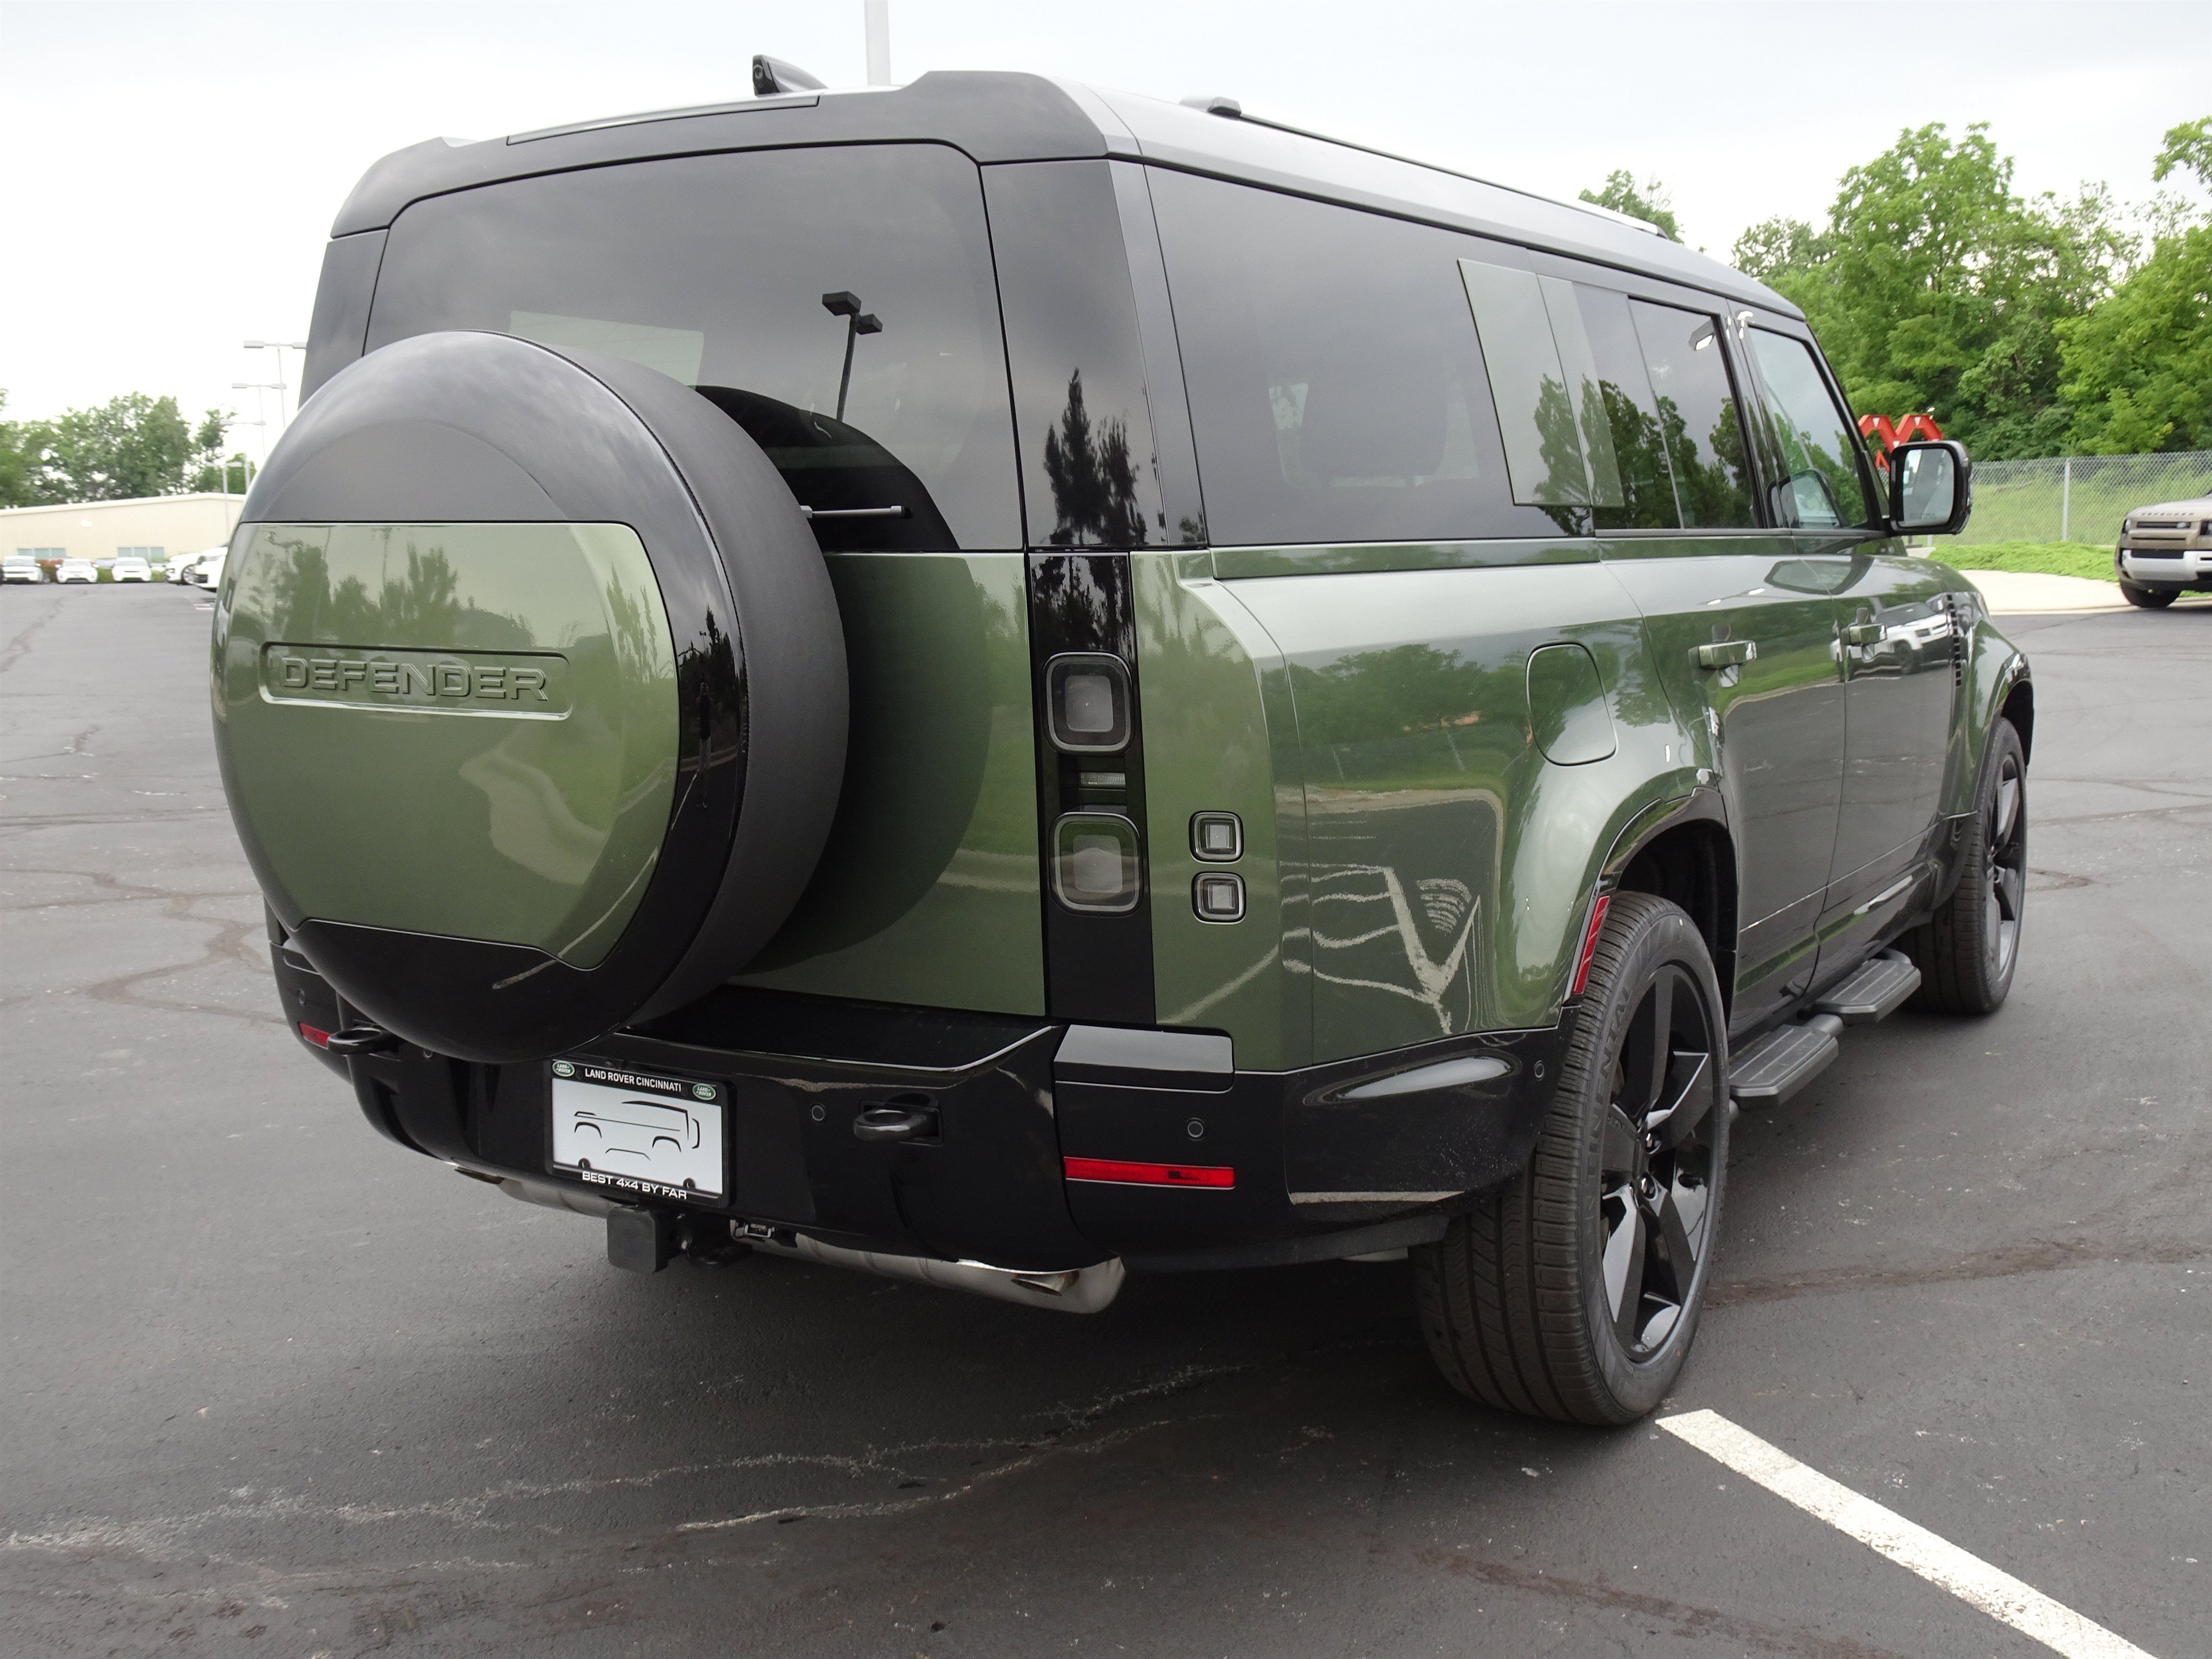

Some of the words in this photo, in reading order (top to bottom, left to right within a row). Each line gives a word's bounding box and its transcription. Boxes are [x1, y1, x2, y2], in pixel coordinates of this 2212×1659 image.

[281, 657, 548, 701] DEFENDER
[585, 1068, 606, 1080] LAND
[608, 1072, 635, 1084] ROVER
[636, 1077, 682, 1092] CINCINNATI
[582, 1171, 613, 1185] BEST
[616, 1178, 638, 1190] 4x4
[642, 1182, 659, 1193] BY
[662, 1186, 687, 1199] FAR
